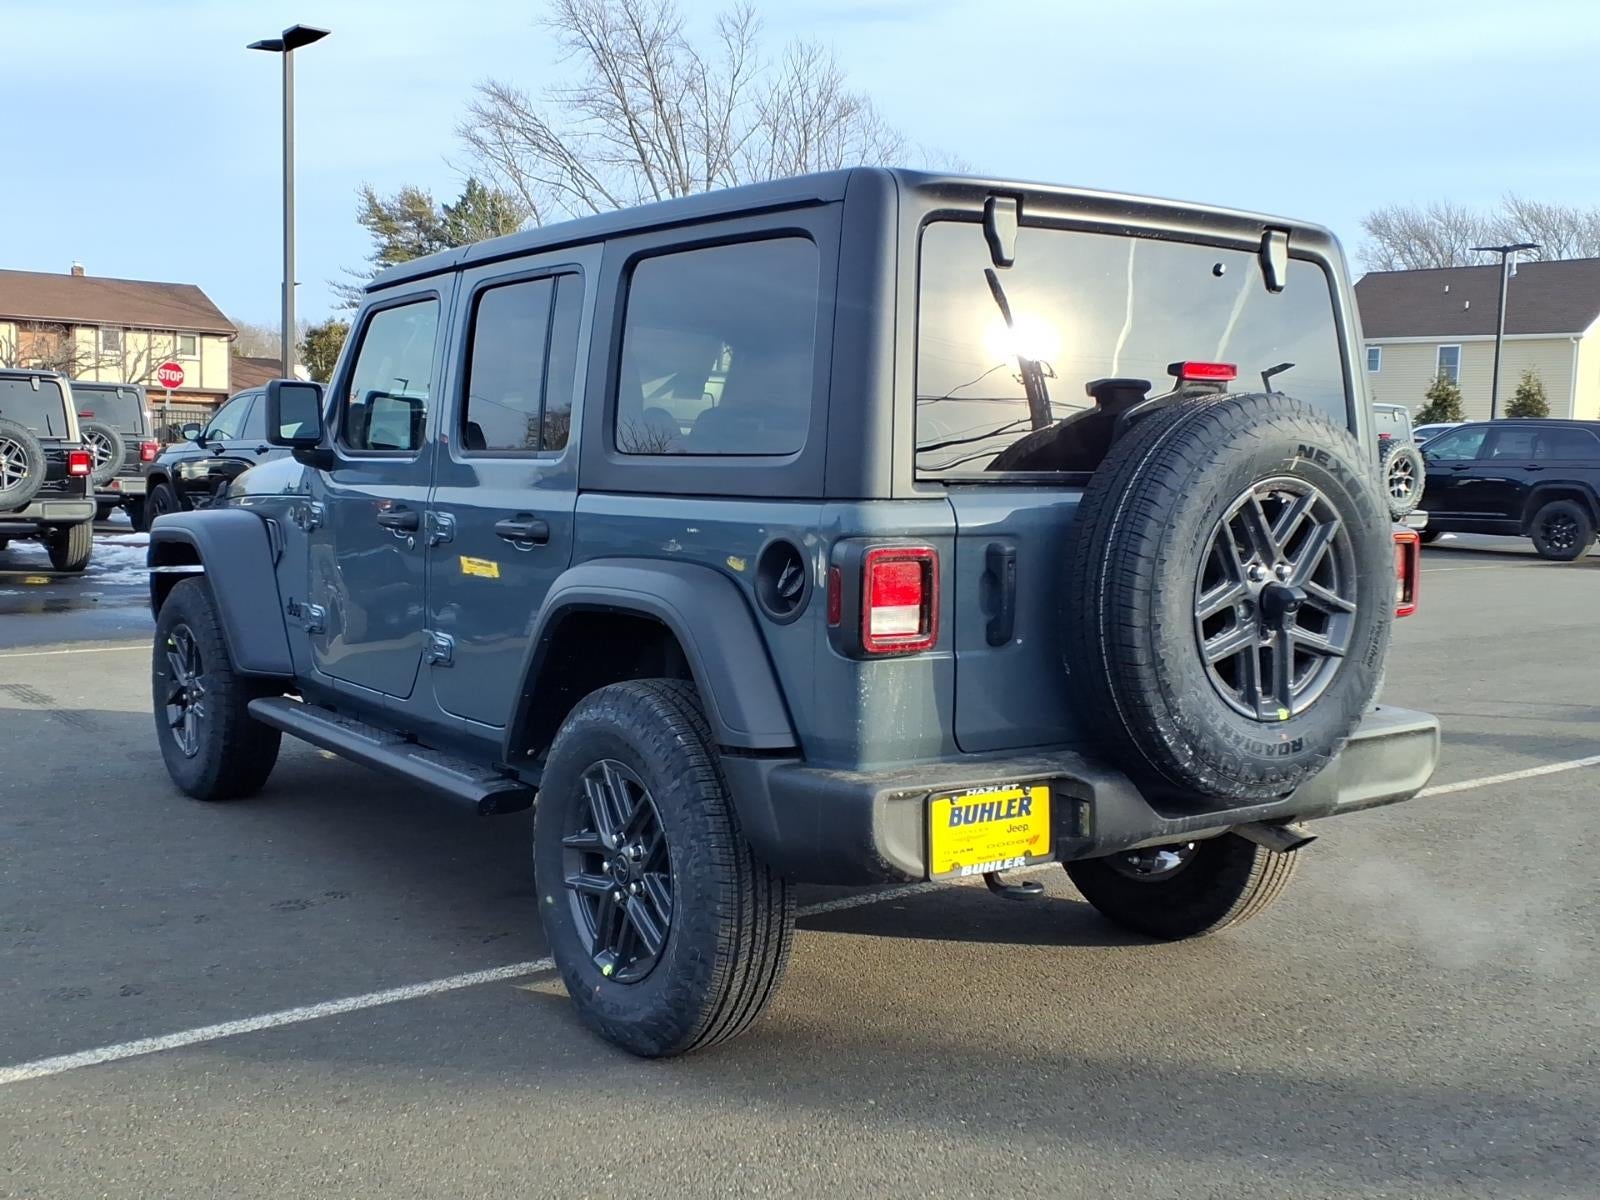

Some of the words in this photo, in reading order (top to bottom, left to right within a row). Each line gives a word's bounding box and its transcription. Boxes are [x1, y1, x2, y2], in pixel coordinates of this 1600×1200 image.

[159, 369, 184, 382] STOP
[966, 784, 1020, 796] HAZLET
[949, 797, 1032, 827] BUHLER
[1006, 823, 1029, 834] Jeep
[961, 856, 1026, 876] BUHLER
